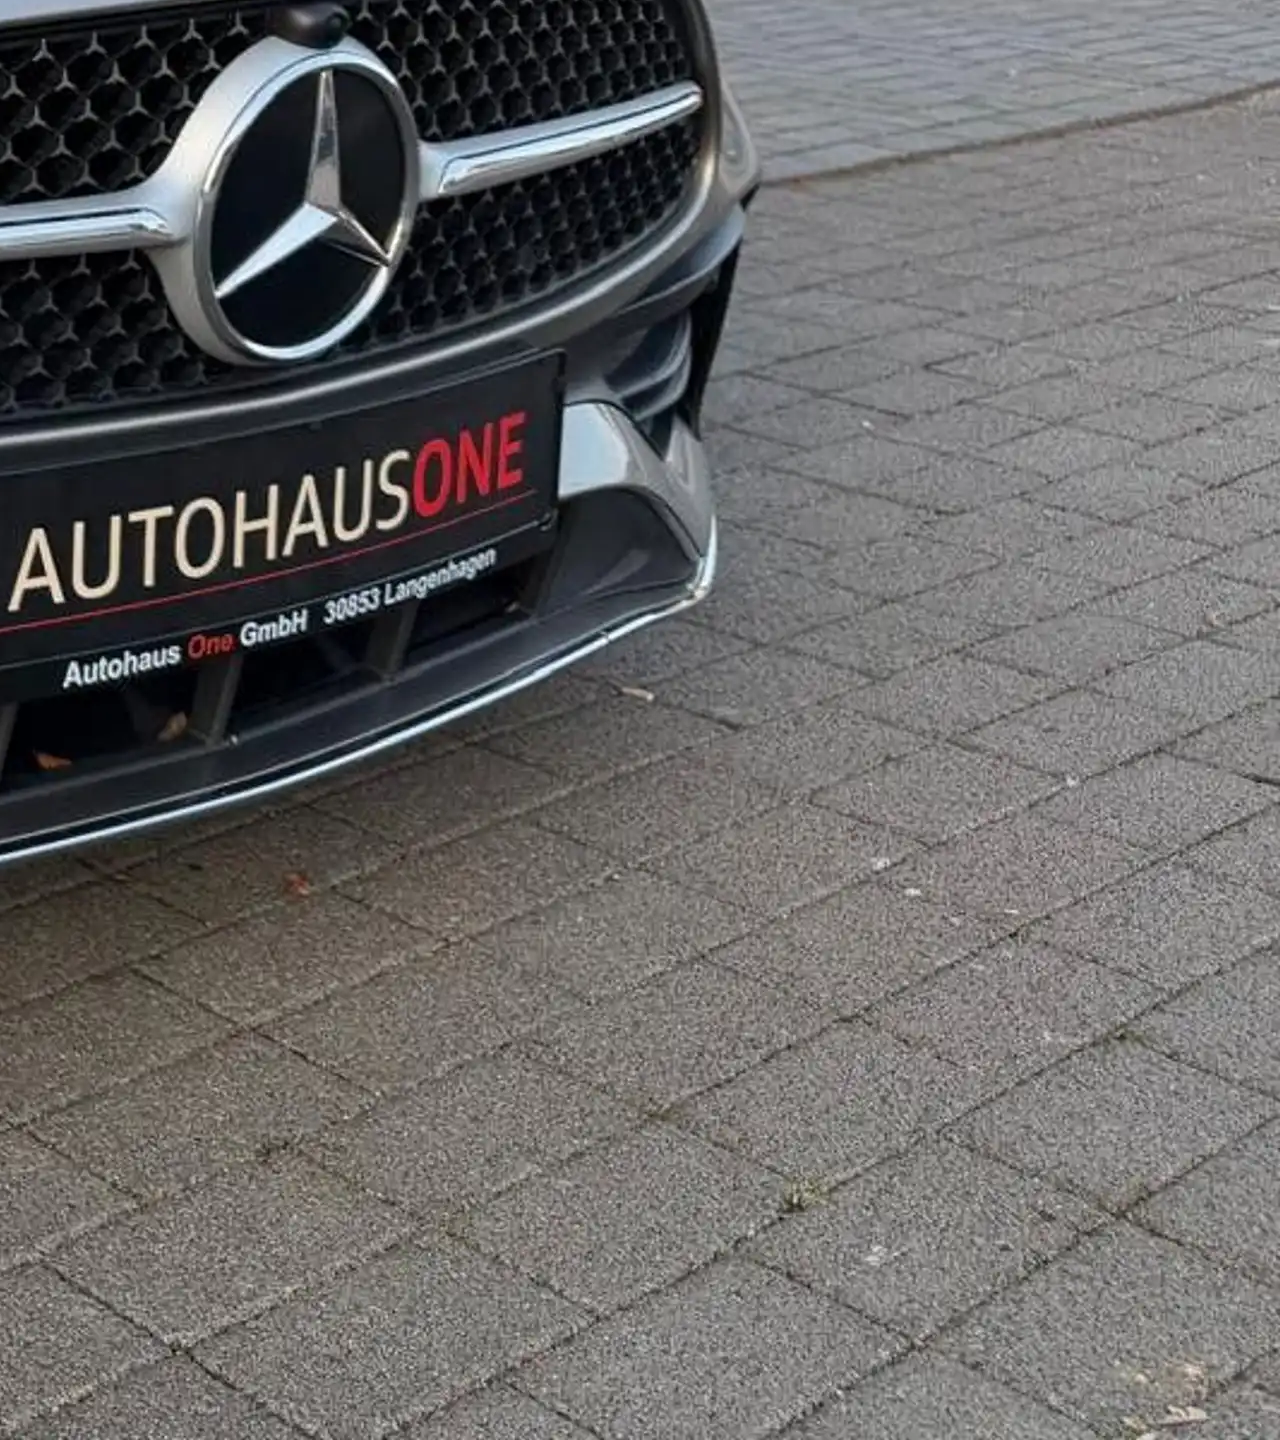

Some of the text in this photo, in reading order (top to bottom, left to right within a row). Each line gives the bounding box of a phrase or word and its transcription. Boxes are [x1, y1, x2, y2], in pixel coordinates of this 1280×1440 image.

[63, 547, 497, 689] Autohaus One GmbH 30853 Langenhagen
